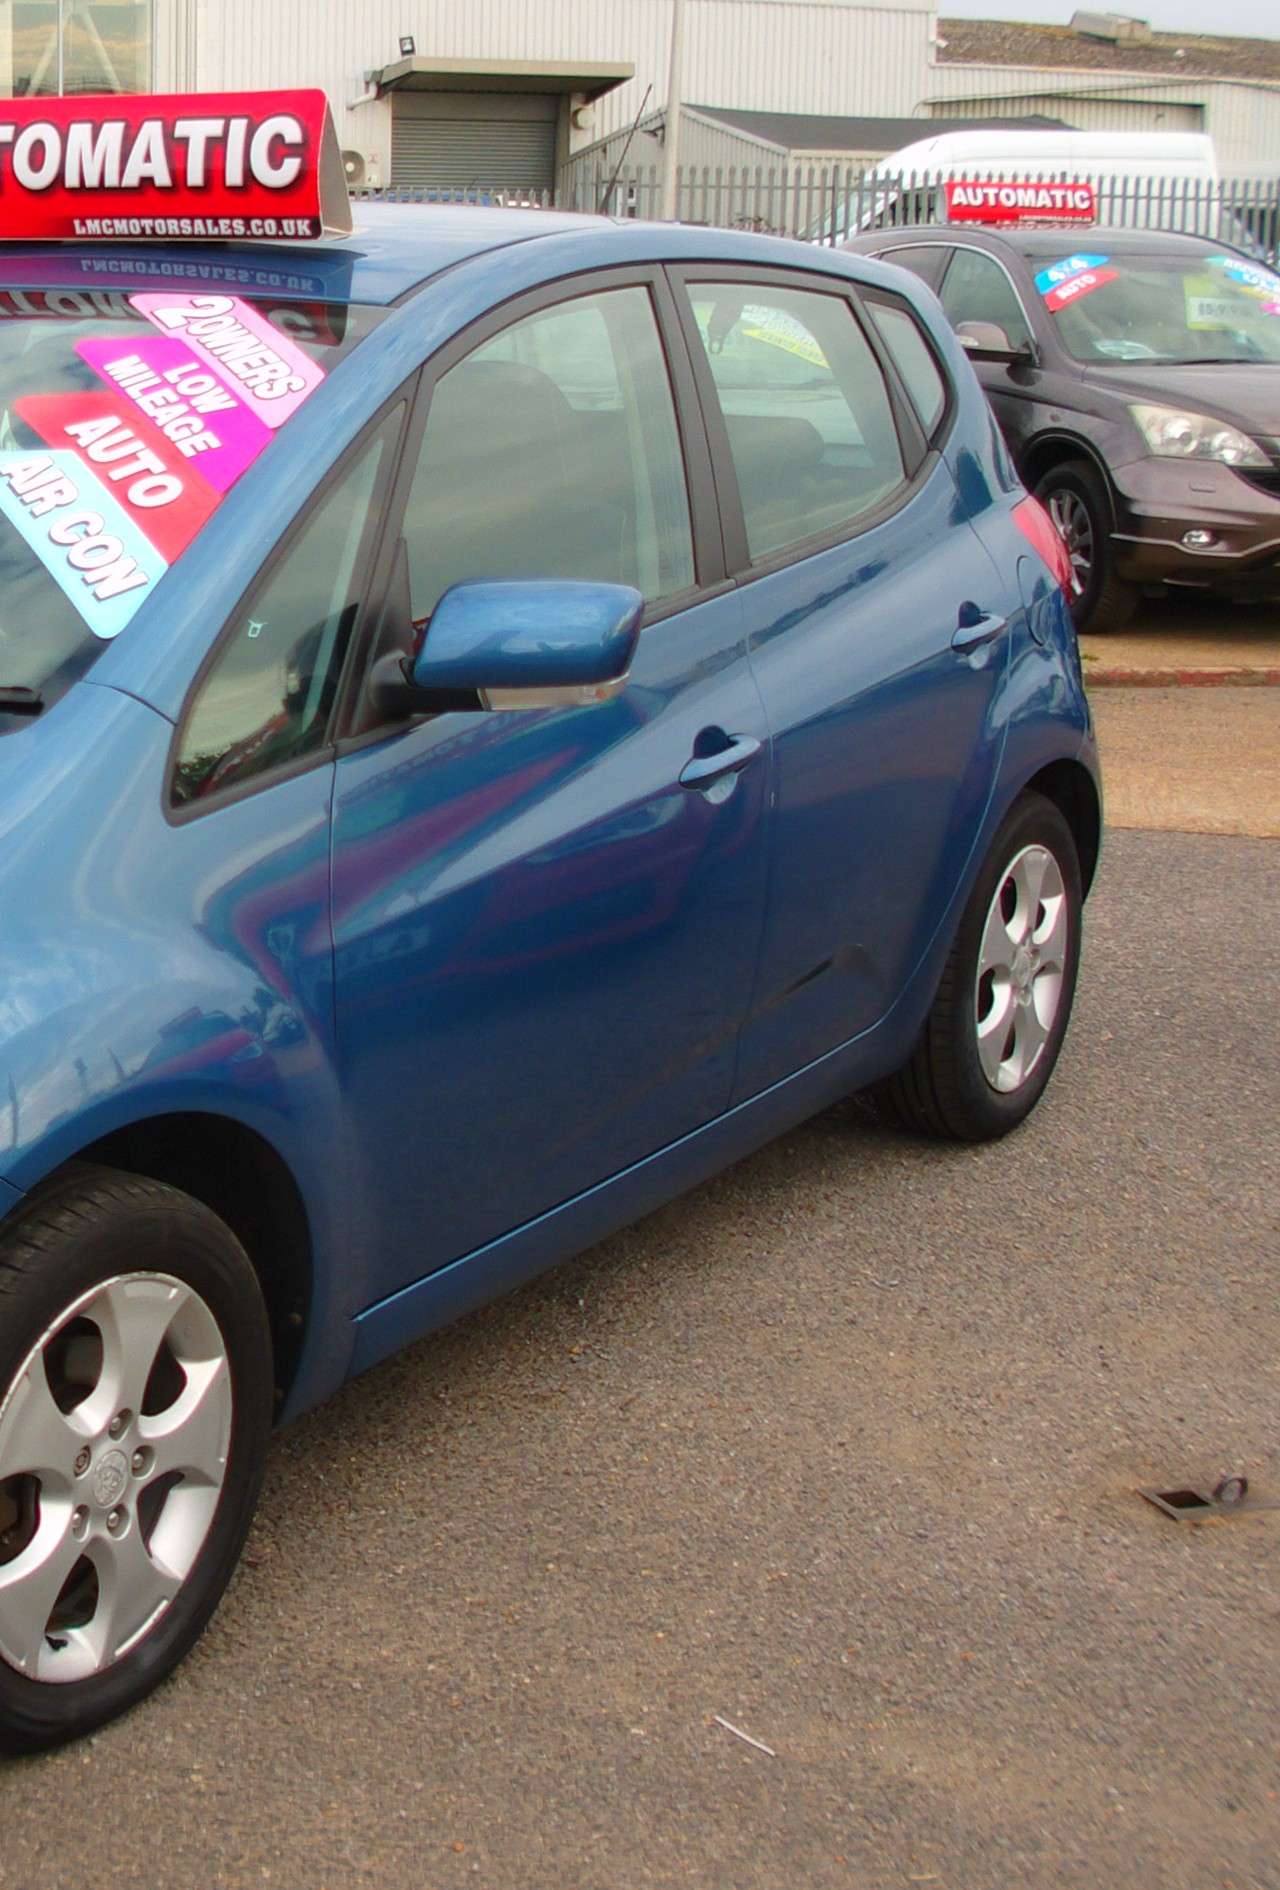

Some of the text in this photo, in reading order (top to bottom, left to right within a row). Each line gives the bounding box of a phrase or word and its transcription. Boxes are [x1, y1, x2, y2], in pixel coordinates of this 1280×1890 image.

[951, 186, 1091, 210] AUTOMATIC
[73, 217, 312, 237] LMCMOTORSALES.CO.UK
[1055, 274, 1097, 300] AUTO
[102, 353, 221, 459] MILEAGE
[161, 361, 238, 415] LOW
[63, 415, 184, 508] AUTO
[47, 510, 150, 602] CON
